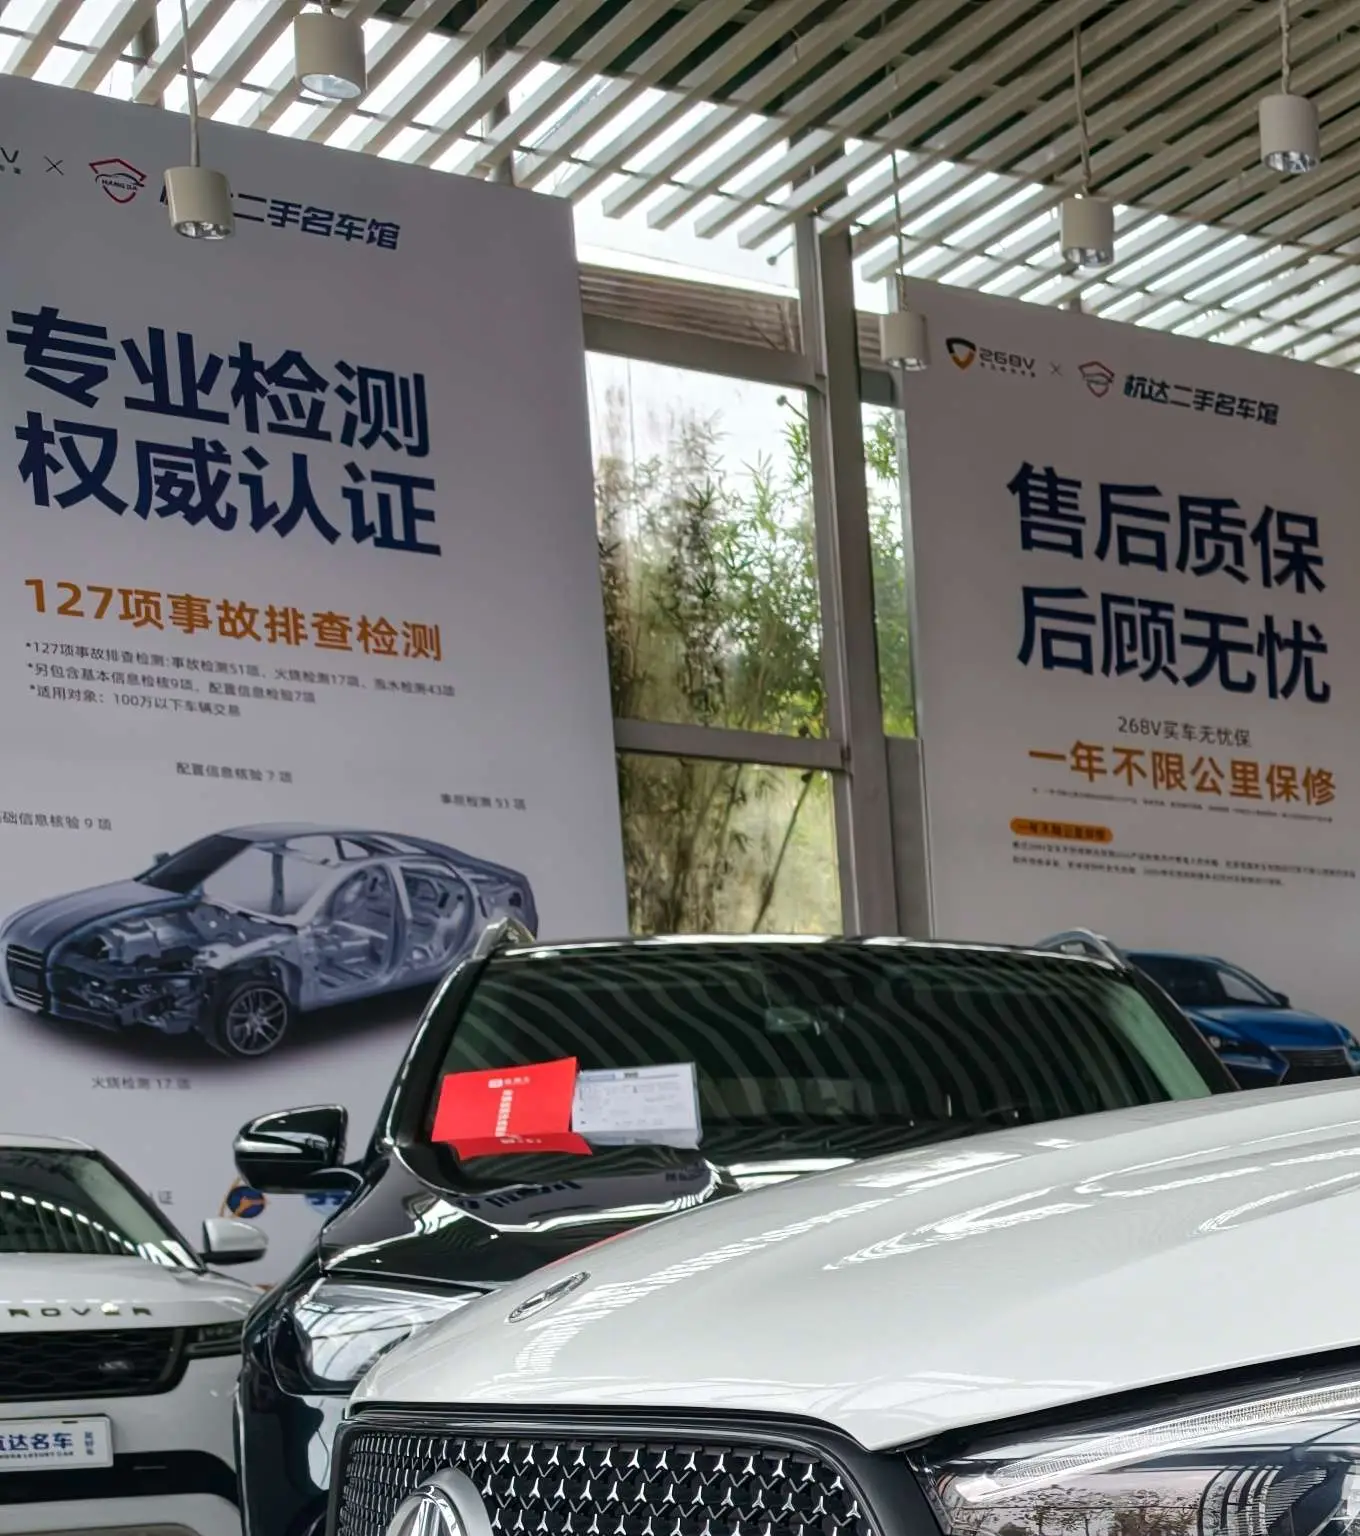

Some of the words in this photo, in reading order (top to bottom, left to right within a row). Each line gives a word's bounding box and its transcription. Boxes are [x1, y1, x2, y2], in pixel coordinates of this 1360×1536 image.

[160, 185, 400, 250] 二手名车馆
[6, 305, 431, 459] 专业检测
[1124, 373, 1280, 426] 杭达二手名车馆
[14, 411, 443, 558] 权威认证
[1006, 461, 1327, 594] 售后质保
[25, 578, 443, 662] 127项事故排查检测
[1016, 586, 1332, 704] 后顾无忧
[1117, 715, 1252, 748] 268V买车无忧保
[1028, 740, 1337, 806] 一年不限公里保修
[0, 810, 80, 830] 础信息核验
